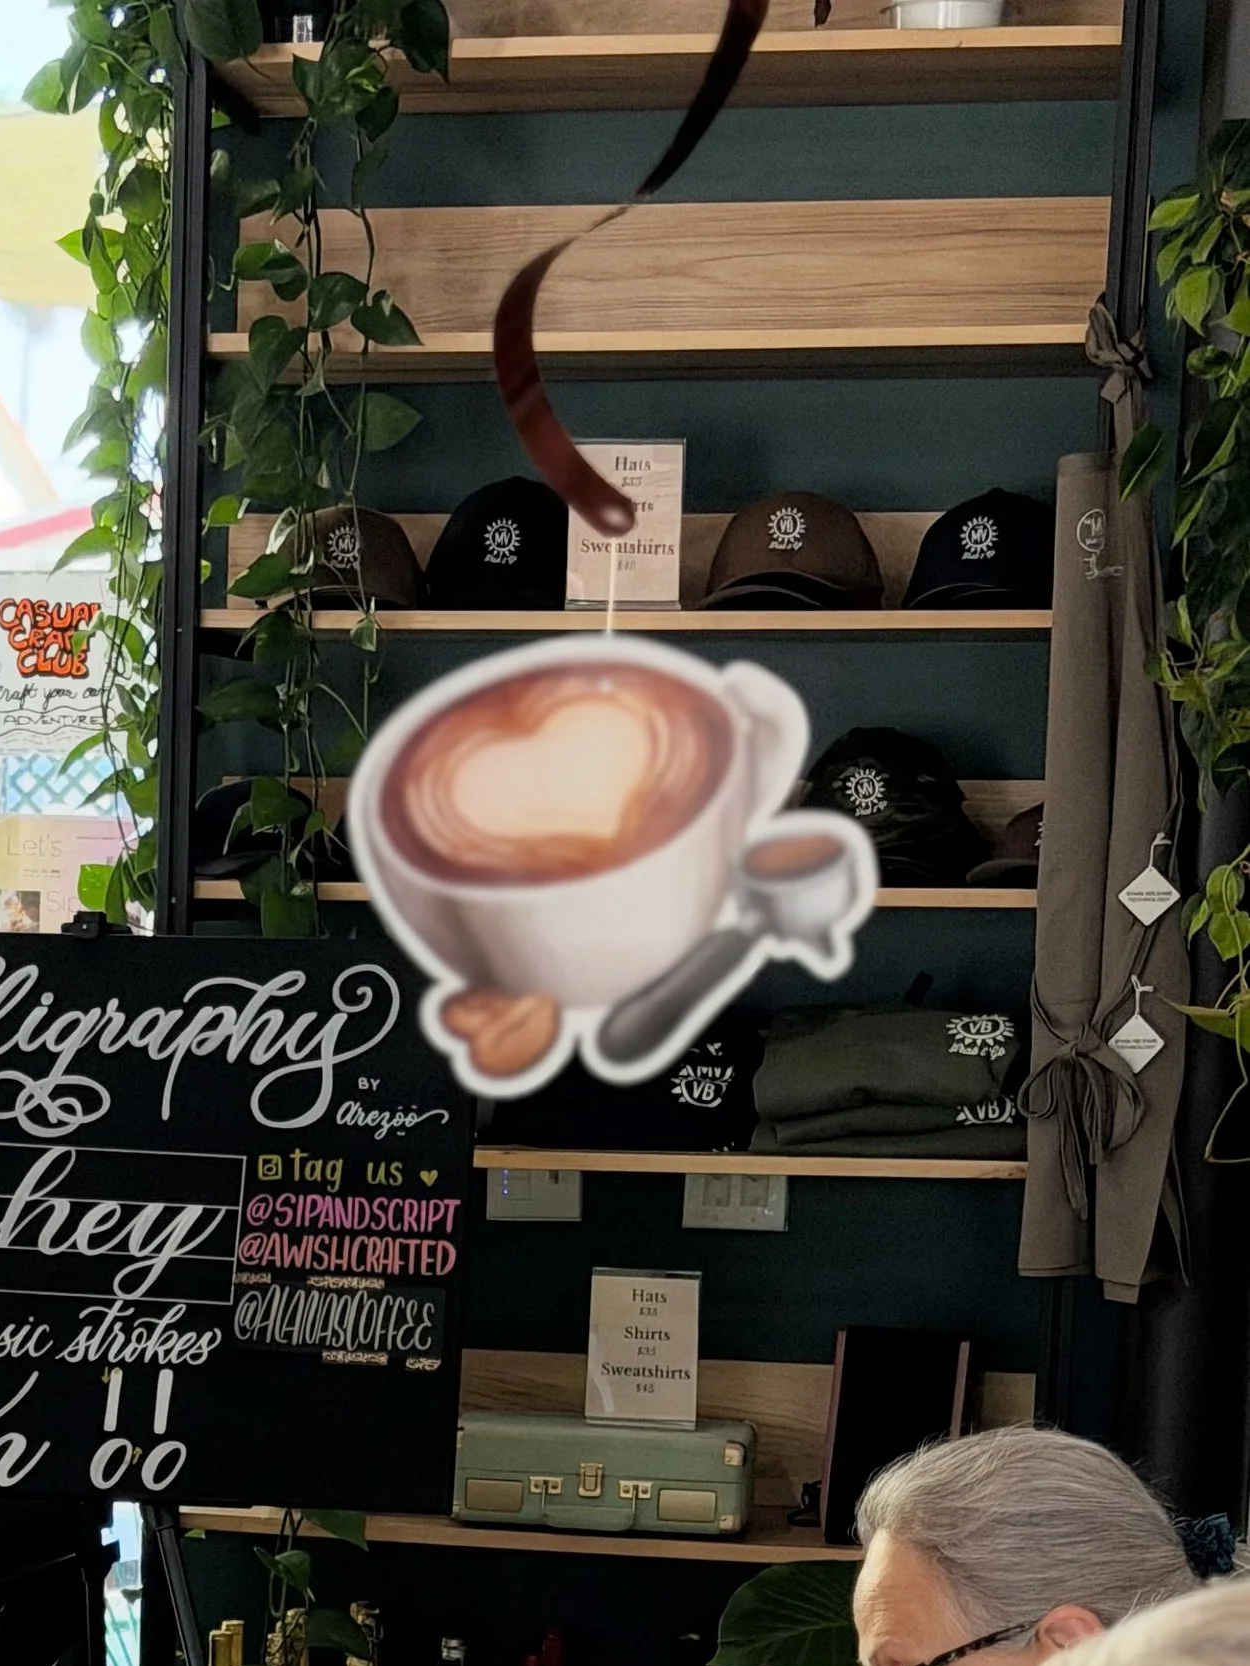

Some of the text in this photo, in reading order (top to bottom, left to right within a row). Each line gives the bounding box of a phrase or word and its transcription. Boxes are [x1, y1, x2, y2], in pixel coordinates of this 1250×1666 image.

[614, 456, 651, 471] Hats
[16, 650, 90, 680] CLUB
[3, 715, 103, 726] ADVENTURE
[6, 833, 63, 858] Let's
[969, 1021, 992, 1034] VB
[358, 1077, 380, 1091] BY
[290, 1148, 403, 1193] tag us
[246, 1193, 462, 1234] @SIPANDSCRIPT
[238, 1232, 457, 1276] @AWISHCRAFTED
[632, 1288, 668, 1304] Hats
[55, 1299, 222, 1366] strokes
[624, 1326, 671, 1342] Shirts
[601, 1362, 691, 1380] Sweatshirts
